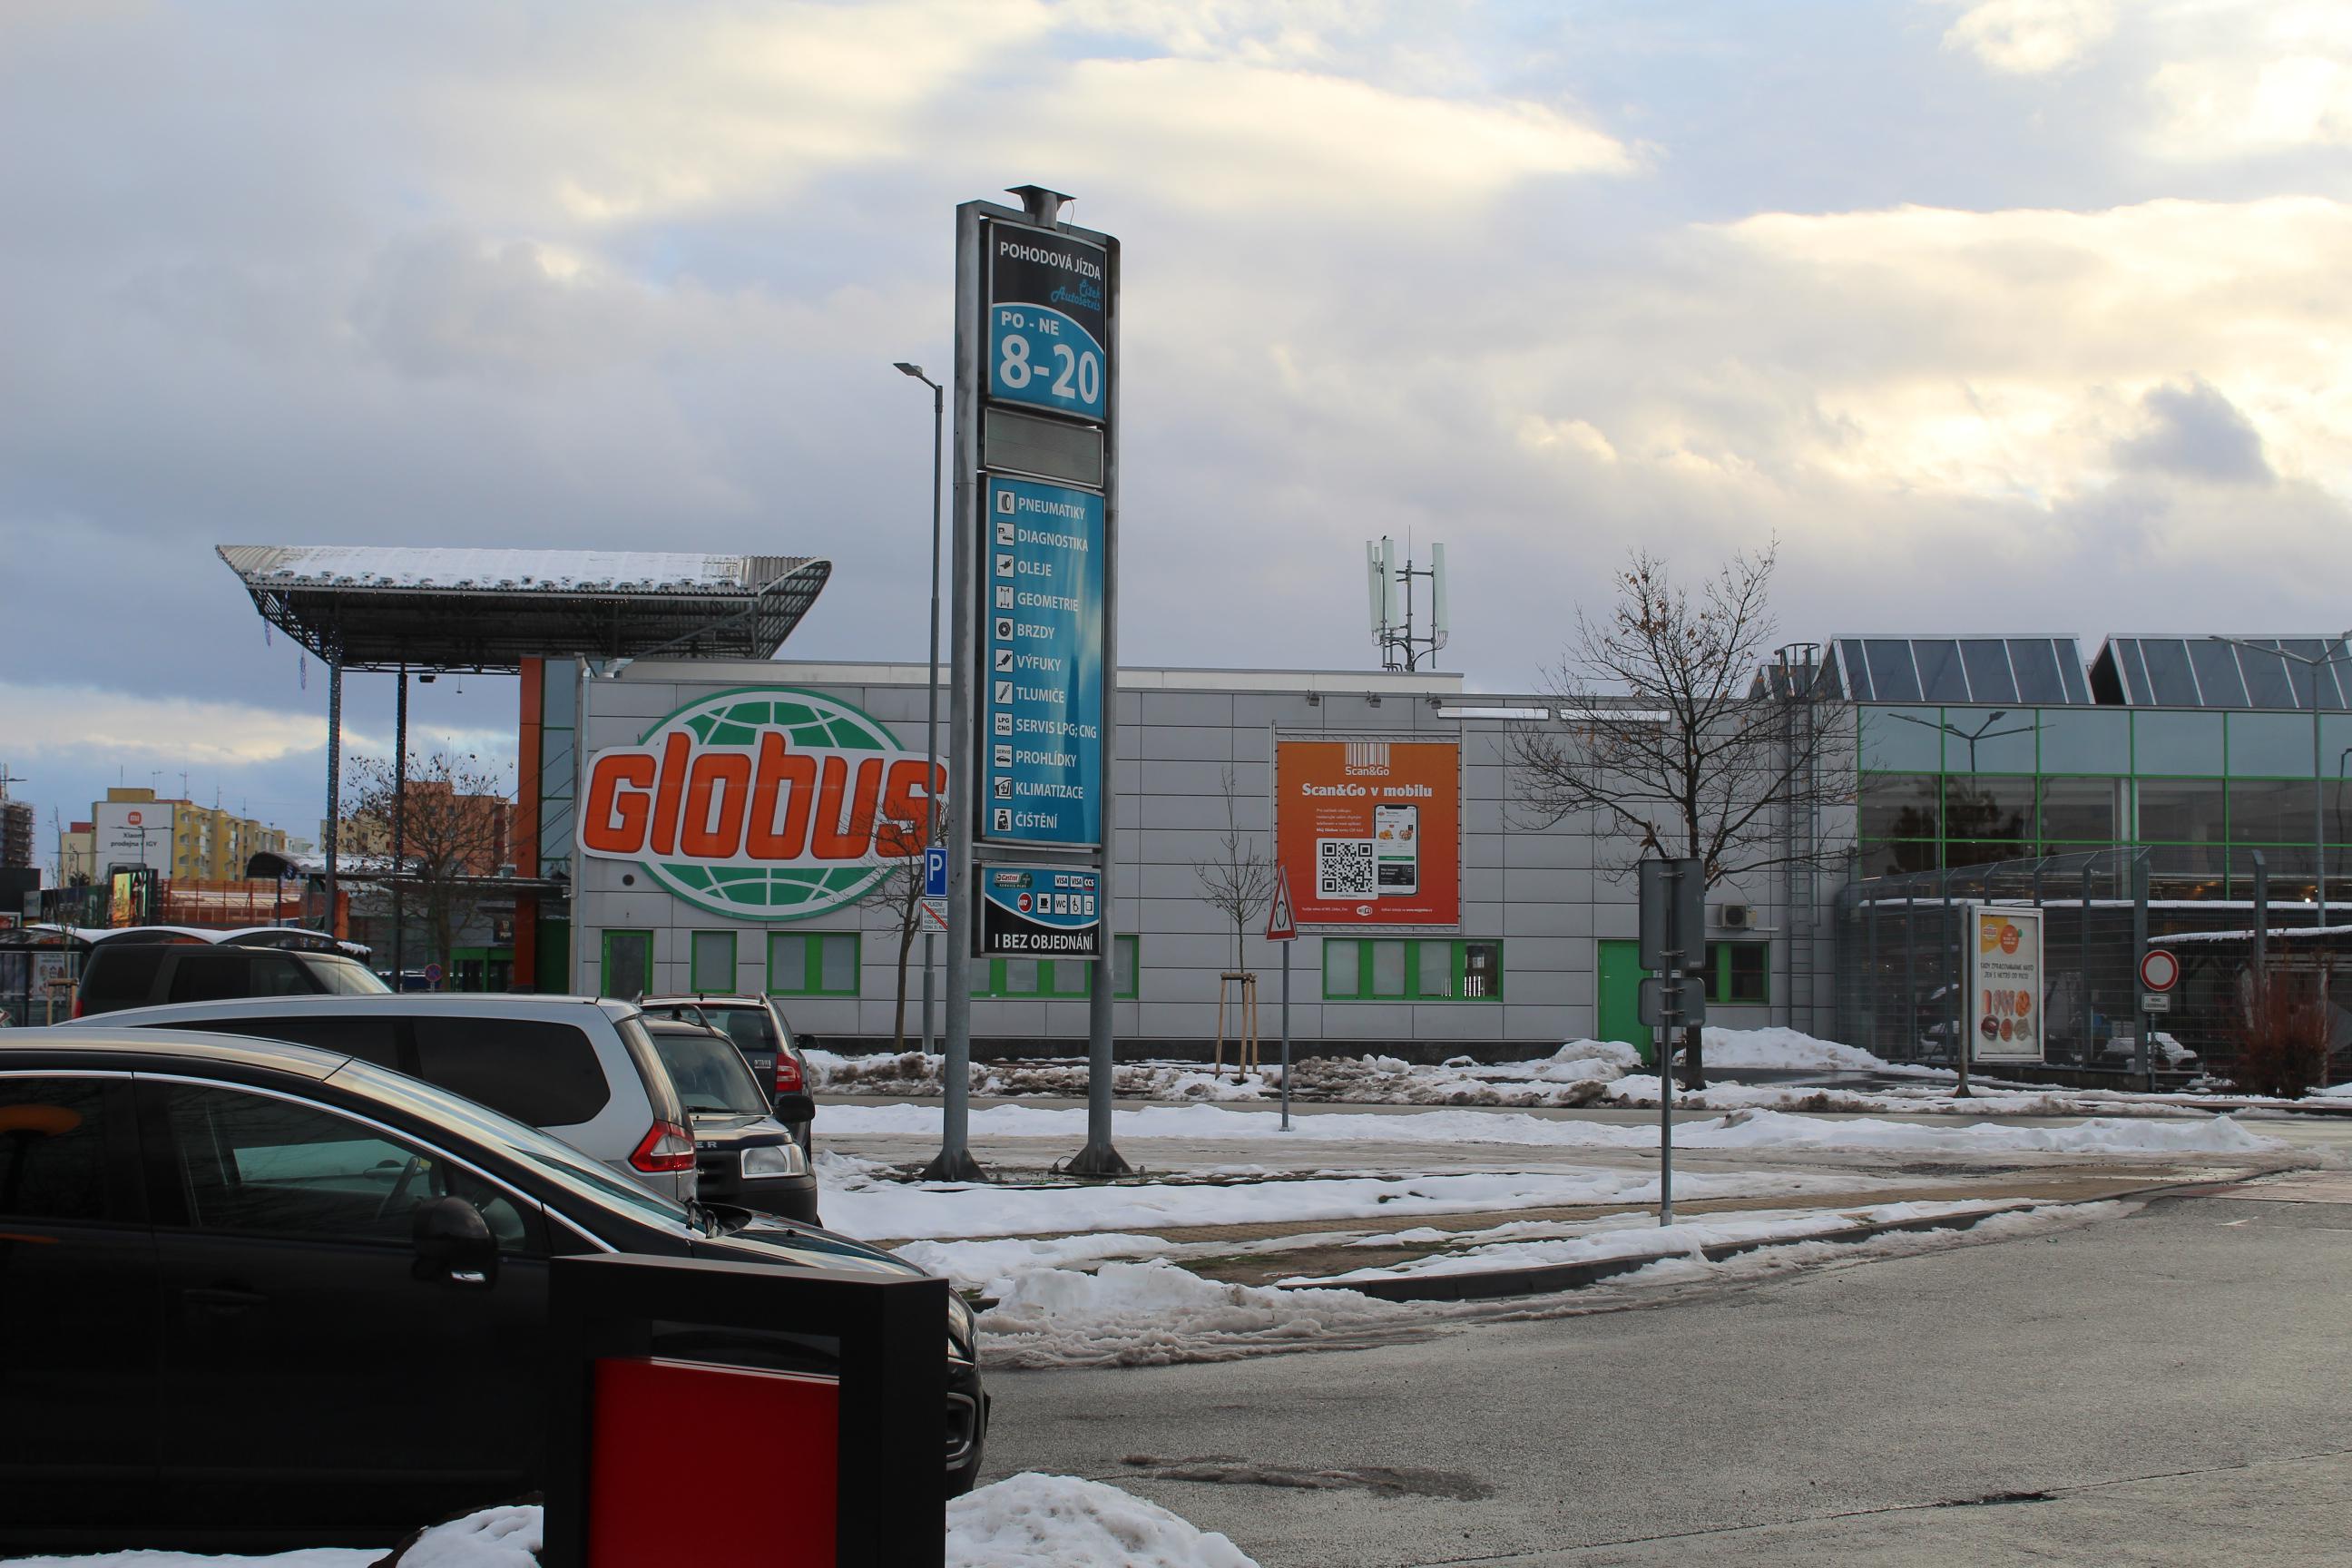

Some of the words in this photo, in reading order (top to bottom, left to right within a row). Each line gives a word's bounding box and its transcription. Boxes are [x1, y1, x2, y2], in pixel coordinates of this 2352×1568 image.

[1000, 241, 1073, 271] POHODOVÁ
[1074, 257, 1101, 280] JÍZDA
[1001, 310, 1024, 328] PO
[1039, 318, 1060, 336] NE
[999, 334, 1100, 405] 8-20
[1018, 497, 1086, 520] PNEUMATIKY
[1017, 528, 1088, 553] DIAGNOSTIKA
[1017, 561, 1053, 577] OLEJE
[1017, 592, 1079, 612] GEOMETRIE
[1017, 623, 1055, 640] BRZDY
[1016, 653, 1062, 671] VÝFUKY
[1016, 686, 1064, 703] TLUMIČE
[1016, 719, 1054, 735] SERVIS
[1079, 725, 1097, 739] CNG
[1016, 750, 1077, 768] PROHLÍDKY
[1345, 766, 1390, 776] Scan&Go
[583, 731, 947, 860] Globus
[1015, 782, 1083, 799] KLIMATIZACE
[1301, 783, 1366, 797] Scan&Go
[1370, 787, 1378, 796] v
[1383, 784, 1433, 797] mobilu
[1015, 811, 1058, 828] ČIŠTĚNÍ
[929, 854, 943, 881] P
[1071, 877, 1083, 886] VISA
[1055, 900, 1066, 908] WC
[995, 934, 998, 948] I
[1003, 934, 1028, 948] BEZ
[1031, 933, 1093, 950] OBJEDNÁNÍ
